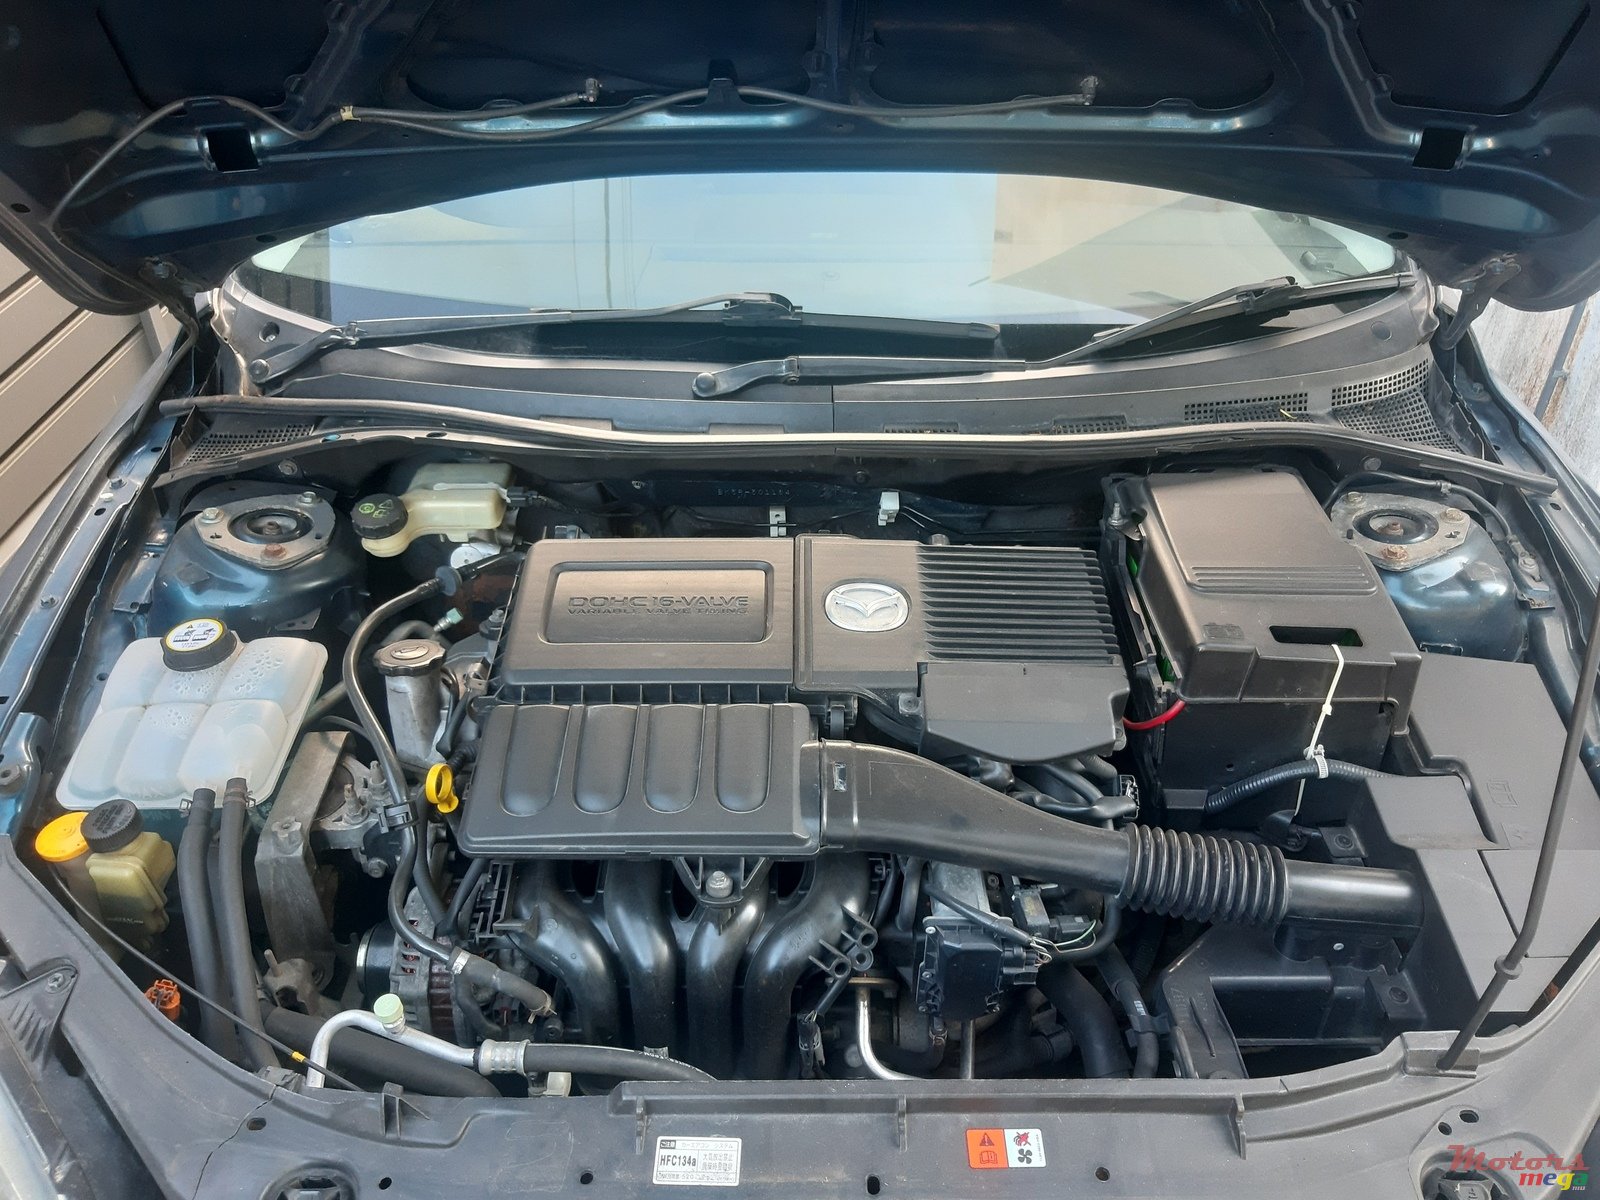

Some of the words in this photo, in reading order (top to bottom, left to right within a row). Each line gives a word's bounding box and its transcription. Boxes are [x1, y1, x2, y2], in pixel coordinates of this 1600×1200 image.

[568, 596, 648, 607] DOHC
[652, 596, 749, 607] 16-VALVE
[660, 1155, 696, 1166] HFC134a
